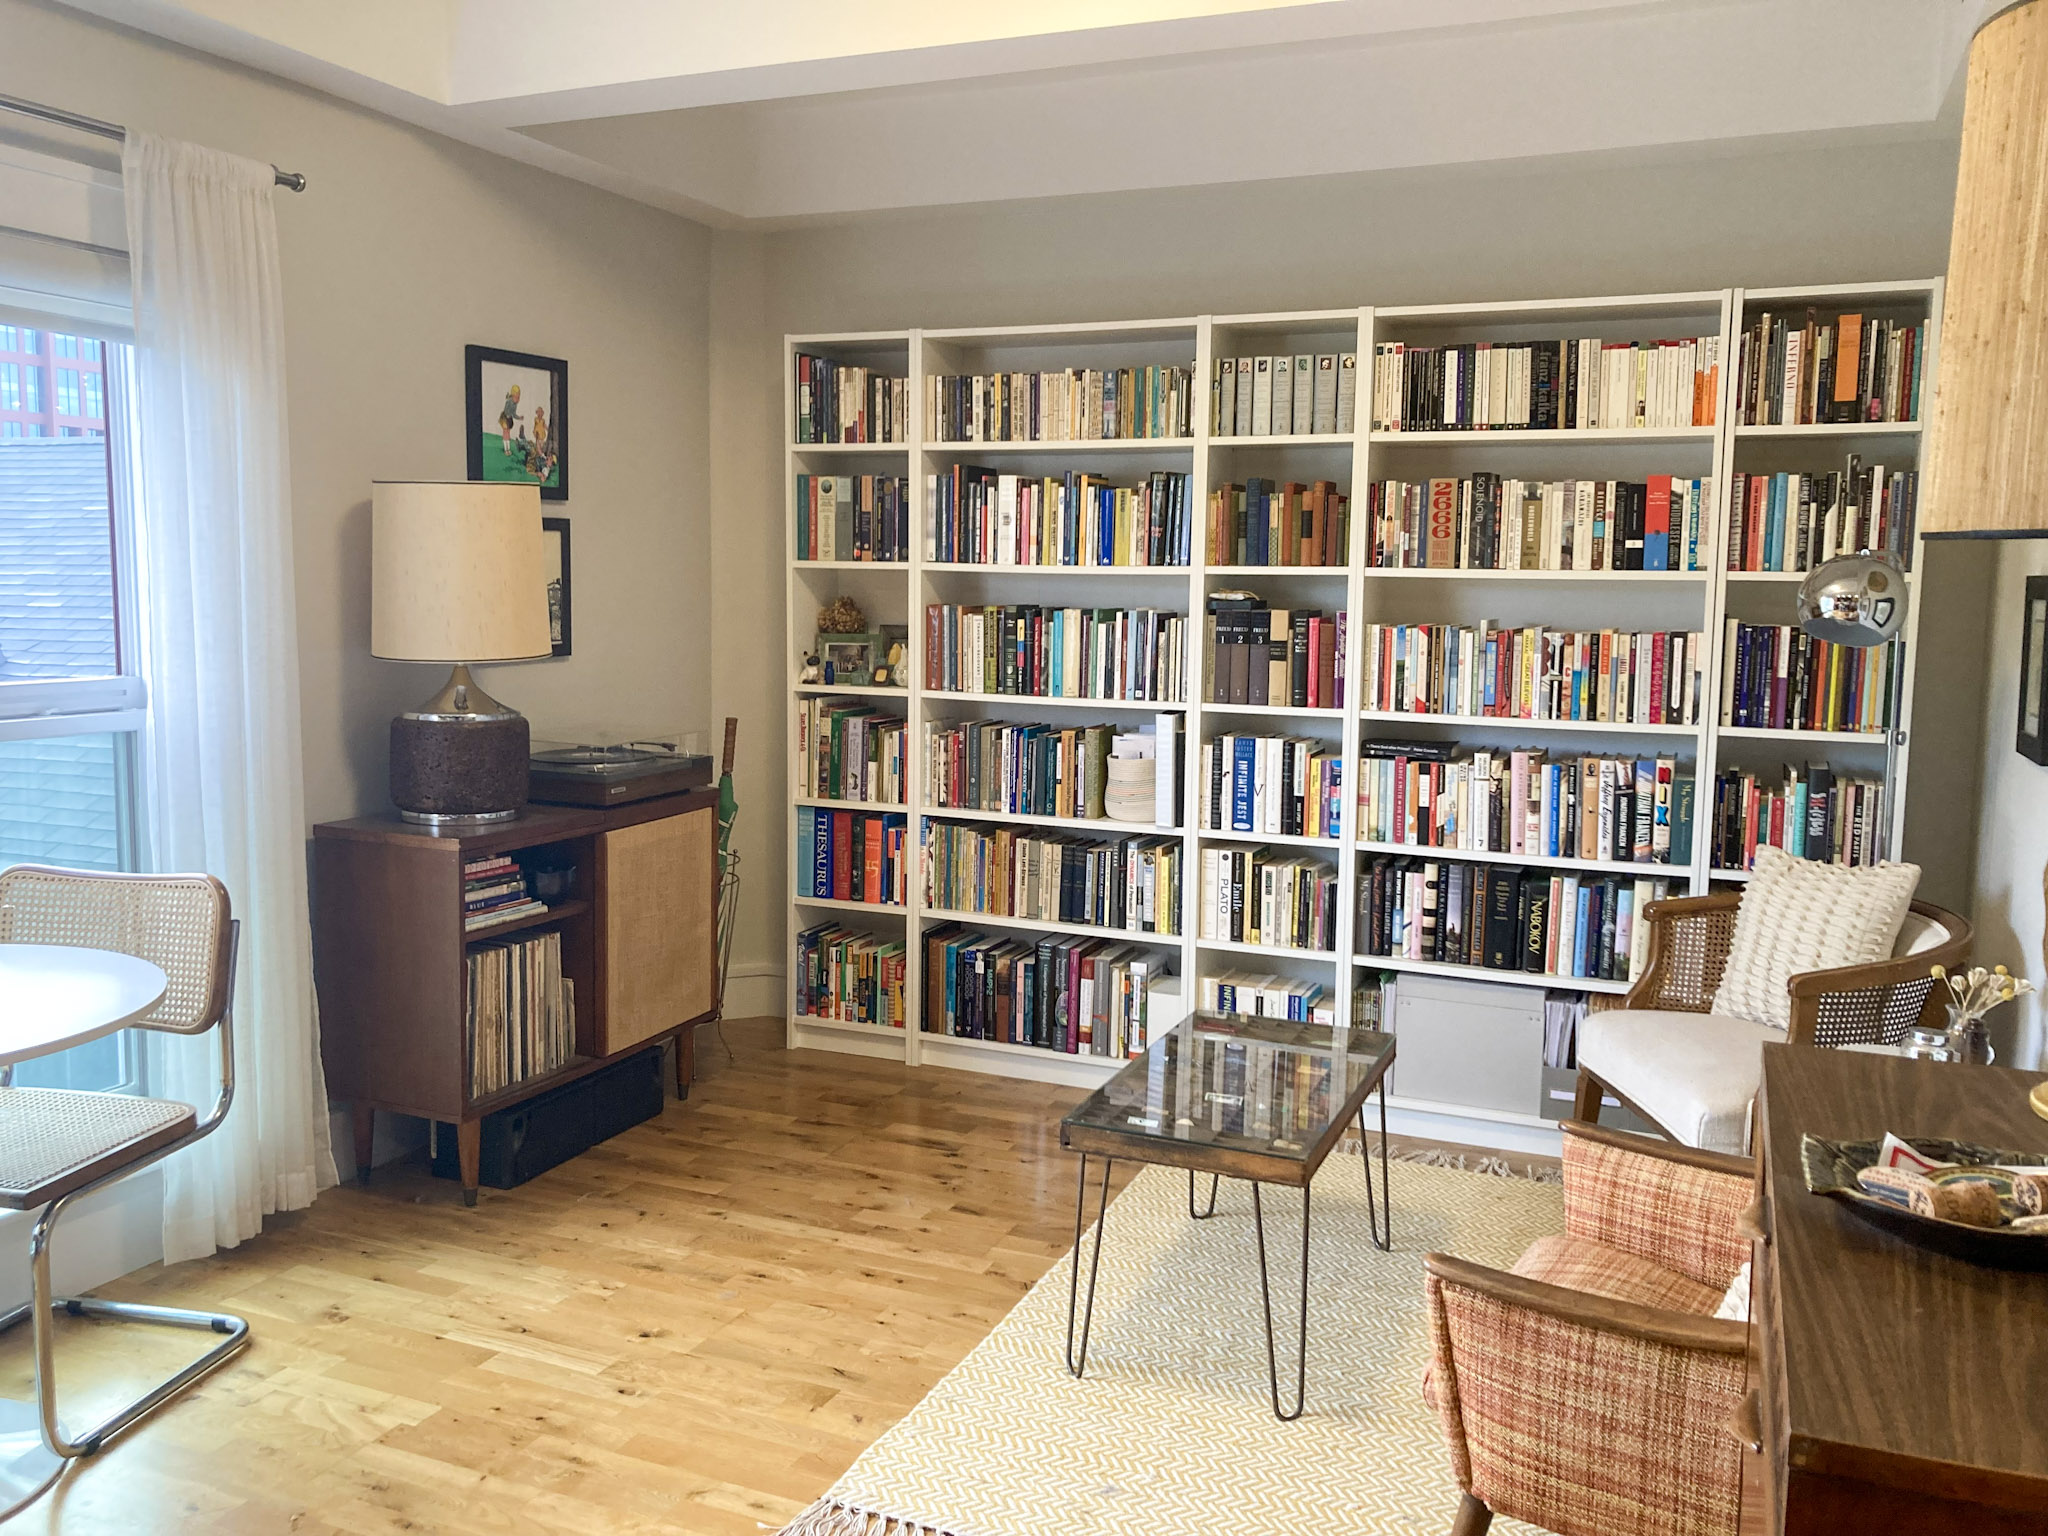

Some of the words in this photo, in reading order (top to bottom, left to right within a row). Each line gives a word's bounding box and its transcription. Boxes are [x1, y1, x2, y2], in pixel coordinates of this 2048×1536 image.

[1432, 482, 1452, 539] 2666
[1475, 476, 1486, 522] SOLENOID
[1238, 636, 1244, 644] 2
[1258, 636, 1262, 644] 3
[1237, 760, 1248, 798] INFINITE
[1236, 800, 1247, 820] JEST
[1620, 796, 1628, 822] JONATHAN
[1618, 823, 1627, 846] FRANZEN
[1636, 816, 1652, 848] FRANZEN
[1854, 817, 1862, 835] RED
[816, 814, 828, 896] THESAURUS
[1220, 878, 1229, 914] PLATO
[1528, 900, 1543, 954] NABOKOV
[1223, 986, 1232, 1016] INFIN
